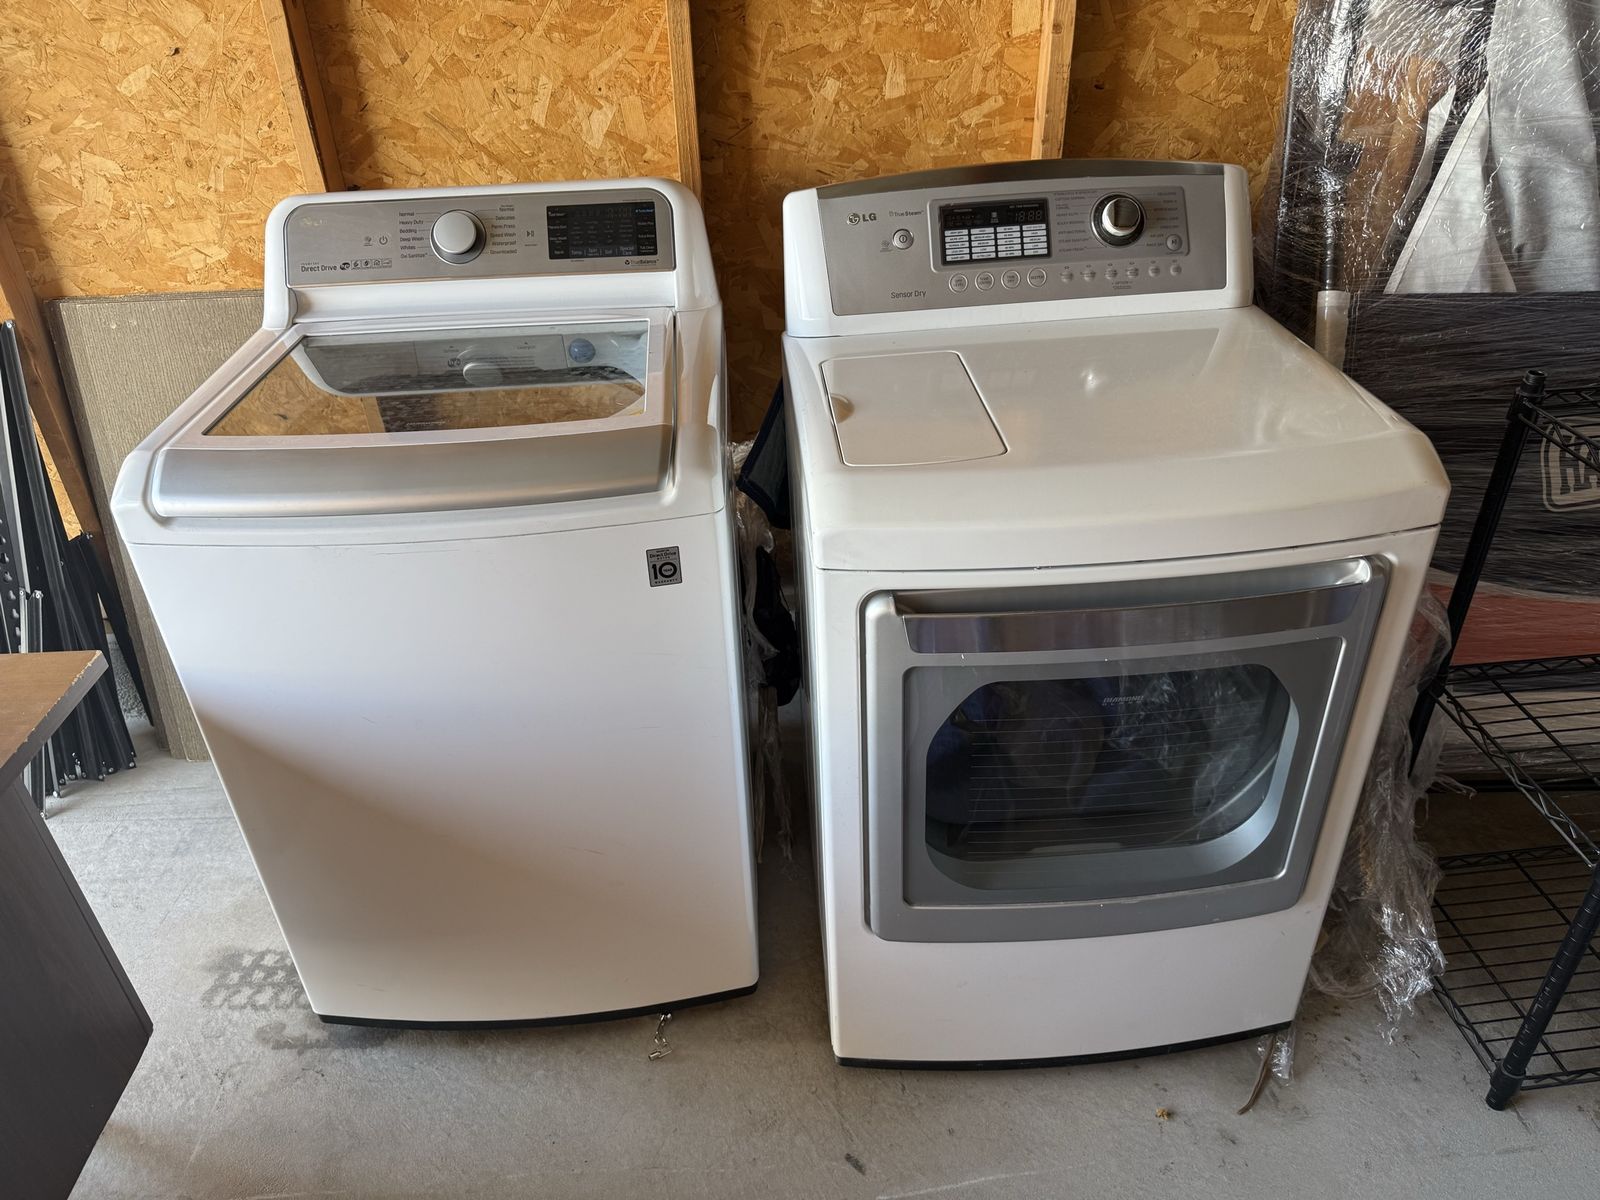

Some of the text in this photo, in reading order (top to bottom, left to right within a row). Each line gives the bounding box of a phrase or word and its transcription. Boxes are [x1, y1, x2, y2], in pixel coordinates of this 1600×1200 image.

[862, 213, 877, 222] LG
[321, 264, 338, 272] Drive
[890, 289, 926, 299] Sensor Dry
[652, 562, 677, 580] 10
